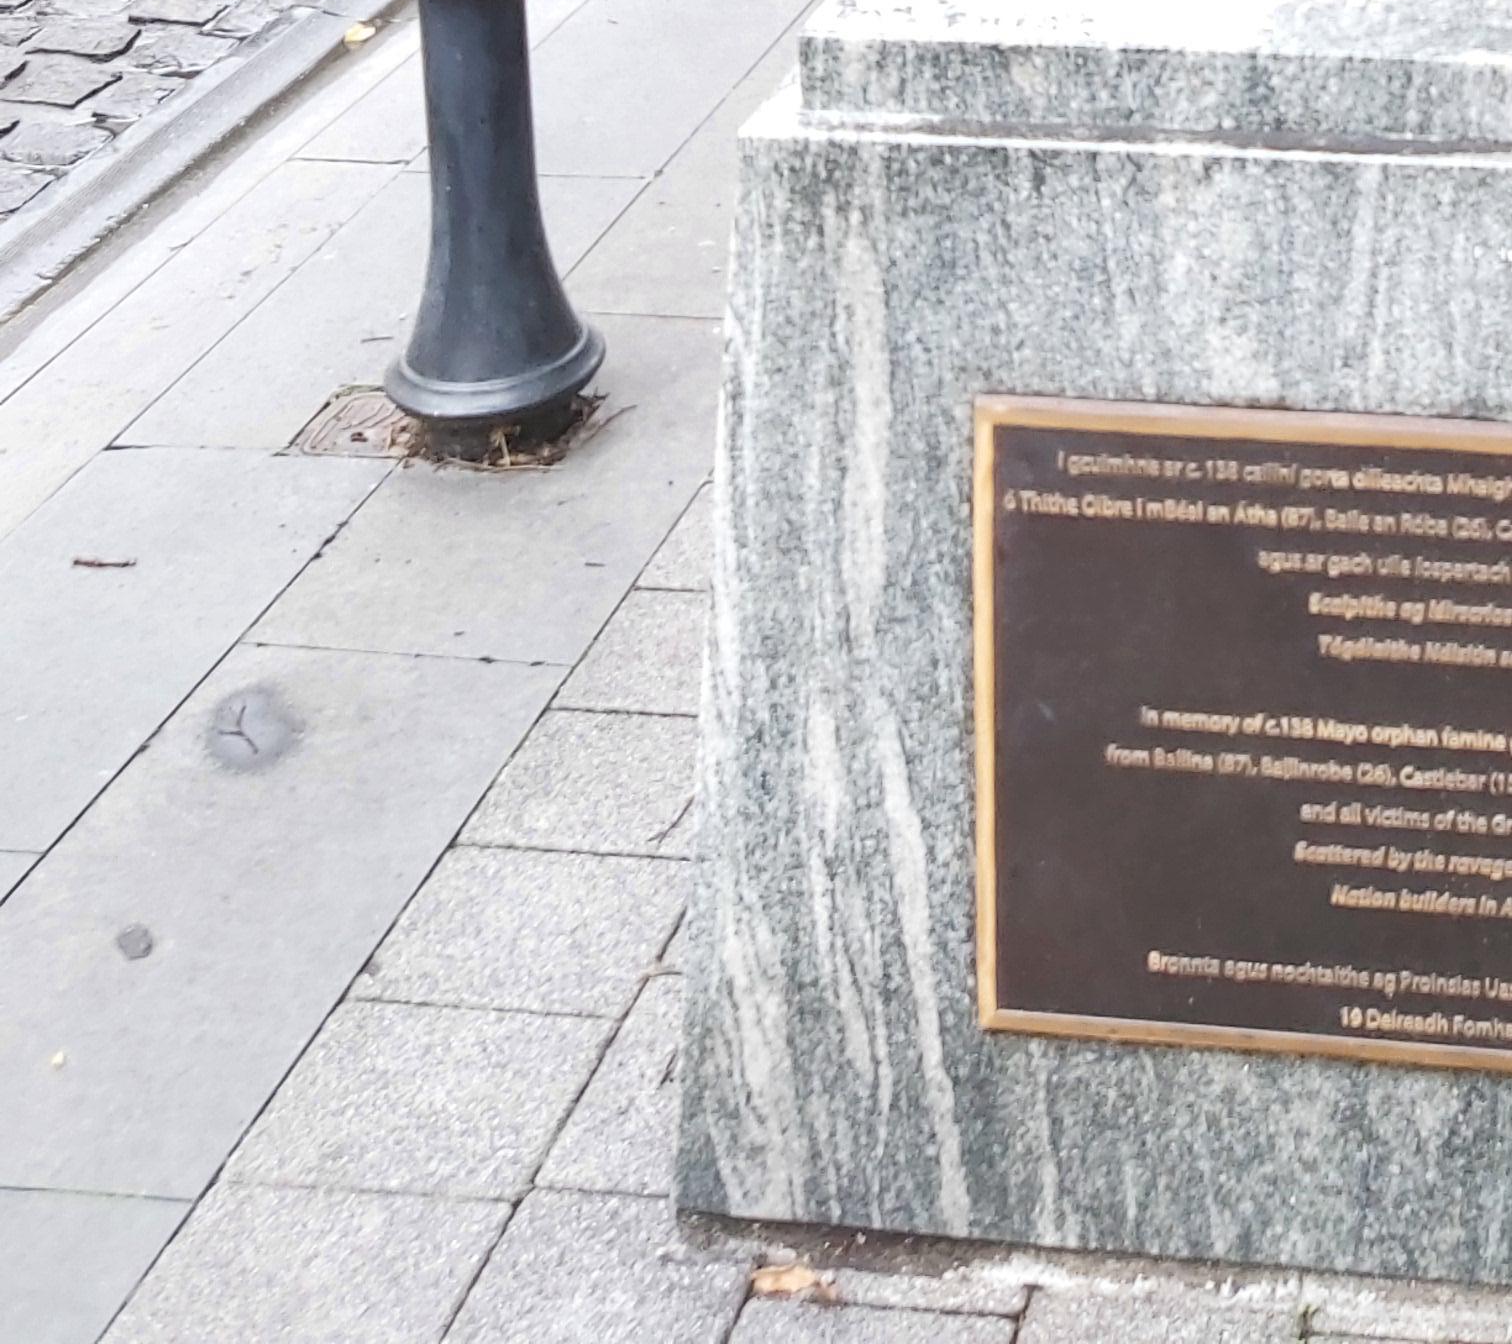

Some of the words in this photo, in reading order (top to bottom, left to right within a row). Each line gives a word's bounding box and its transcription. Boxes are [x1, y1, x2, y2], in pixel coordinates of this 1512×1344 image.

[1068, 454, 1159, 475] gcuimhne
[1164, 461, 1183, 476] ar
[1301, 469, 1350, 488] gorta
[1019, 490, 1079, 515] Thithe
[1082, 494, 1134, 518] Oibre
[1207, 506, 1229, 522] an
[1325, 509, 1370, 531] Baile
[1373, 515, 1397, 532] an
[1258, 551, 1303, 572] agus
[1304, 554, 1327, 570] ar
[1327, 553, 1375, 577] gach
[1377, 555, 1412, 576] uile
[1400, 602, 1426, 624] ag
[1140, 706, 1159, 725] In
[1162, 711, 1240, 734] memory
[1242, 713, 1265, 733] of
[1316, 719, 1369, 744] Mayo
[1371, 724, 1439, 746] orphan
[1441, 726, 1507, 751] famine
[1105, 744, 1150, 765] from
[1153, 748, 1214, 770] Ballina
[1260, 756, 1353, 780] Ballinrobe
[1400, 766, 1487, 790] Castlebar
[1301, 802, 1337, 822] and
[1339, 803, 1362, 823] all
[1365, 806, 1430, 828] victims
[1434, 810, 1455, 830] of
[1456, 811, 1488, 833] the
[1294, 841, 1387, 866] Scattered
[1388, 847, 1413, 871] by
[1414, 850, 1446, 870] the
[1330, 885, 1397, 908] Nation
[1399, 889, 1477, 913] builders
[1479, 895, 1498, 914] in
[1147, 951, 1220, 974] Bronnta
[1224, 960, 1268, 979] agus
[1271, 963, 1369, 987] nochtaithe
[1374, 973, 1397, 997] ag
[1400, 971, 1482, 995] Proinsias
[1340, 1007, 1363, 1027] 19
[1366, 1009, 1449, 1033] Deireadh
